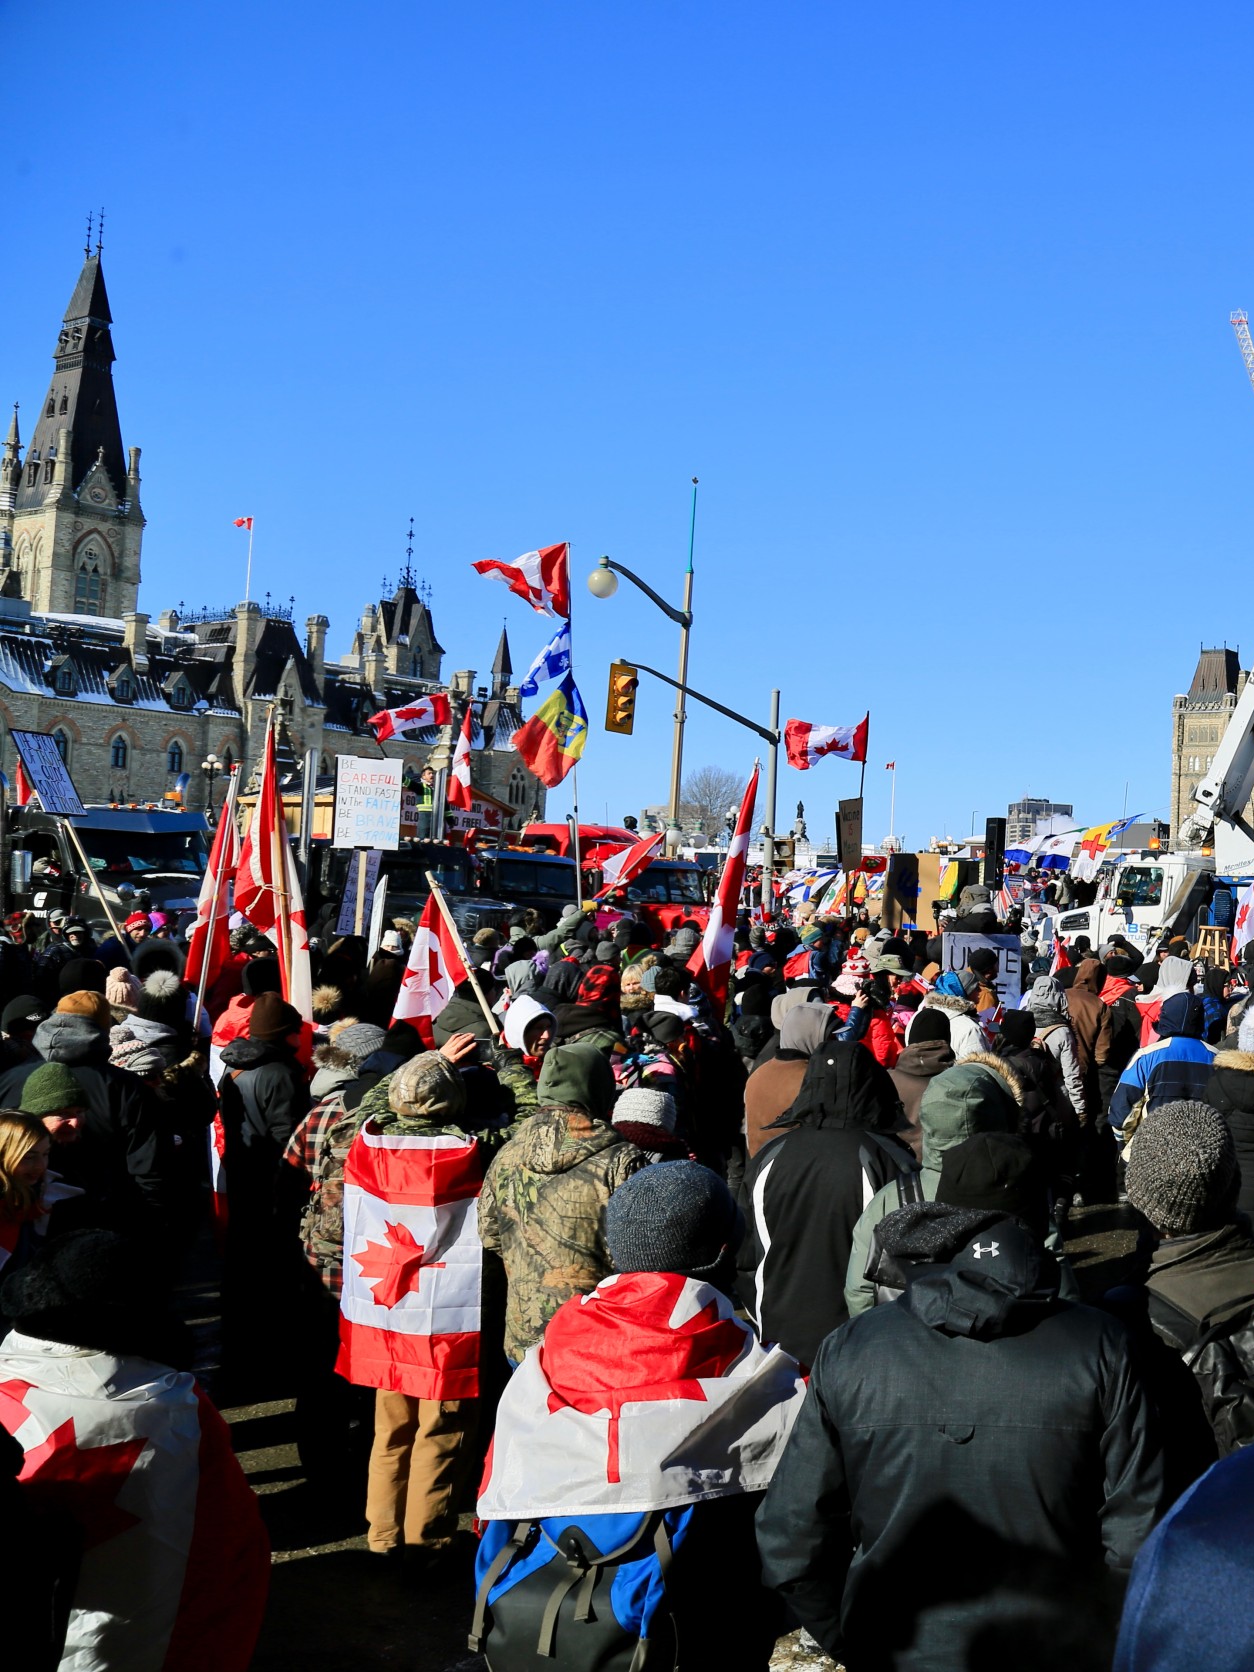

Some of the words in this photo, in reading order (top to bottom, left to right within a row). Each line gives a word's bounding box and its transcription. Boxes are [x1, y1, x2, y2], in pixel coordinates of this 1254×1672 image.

[341, 759, 357, 770] BE
[341, 772, 399, 786] CAREFUL
[339, 784, 371, 796] STAND
[375, 787, 400, 799] FAST
[365, 797, 400, 812] FAITH
[339, 808, 352, 819] BE
[355, 814, 399, 829] BRAVE
[336, 827, 351, 838] BE
[351, 830, 399, 844] STRONG
[1115, 922, 1150, 934] ABS
